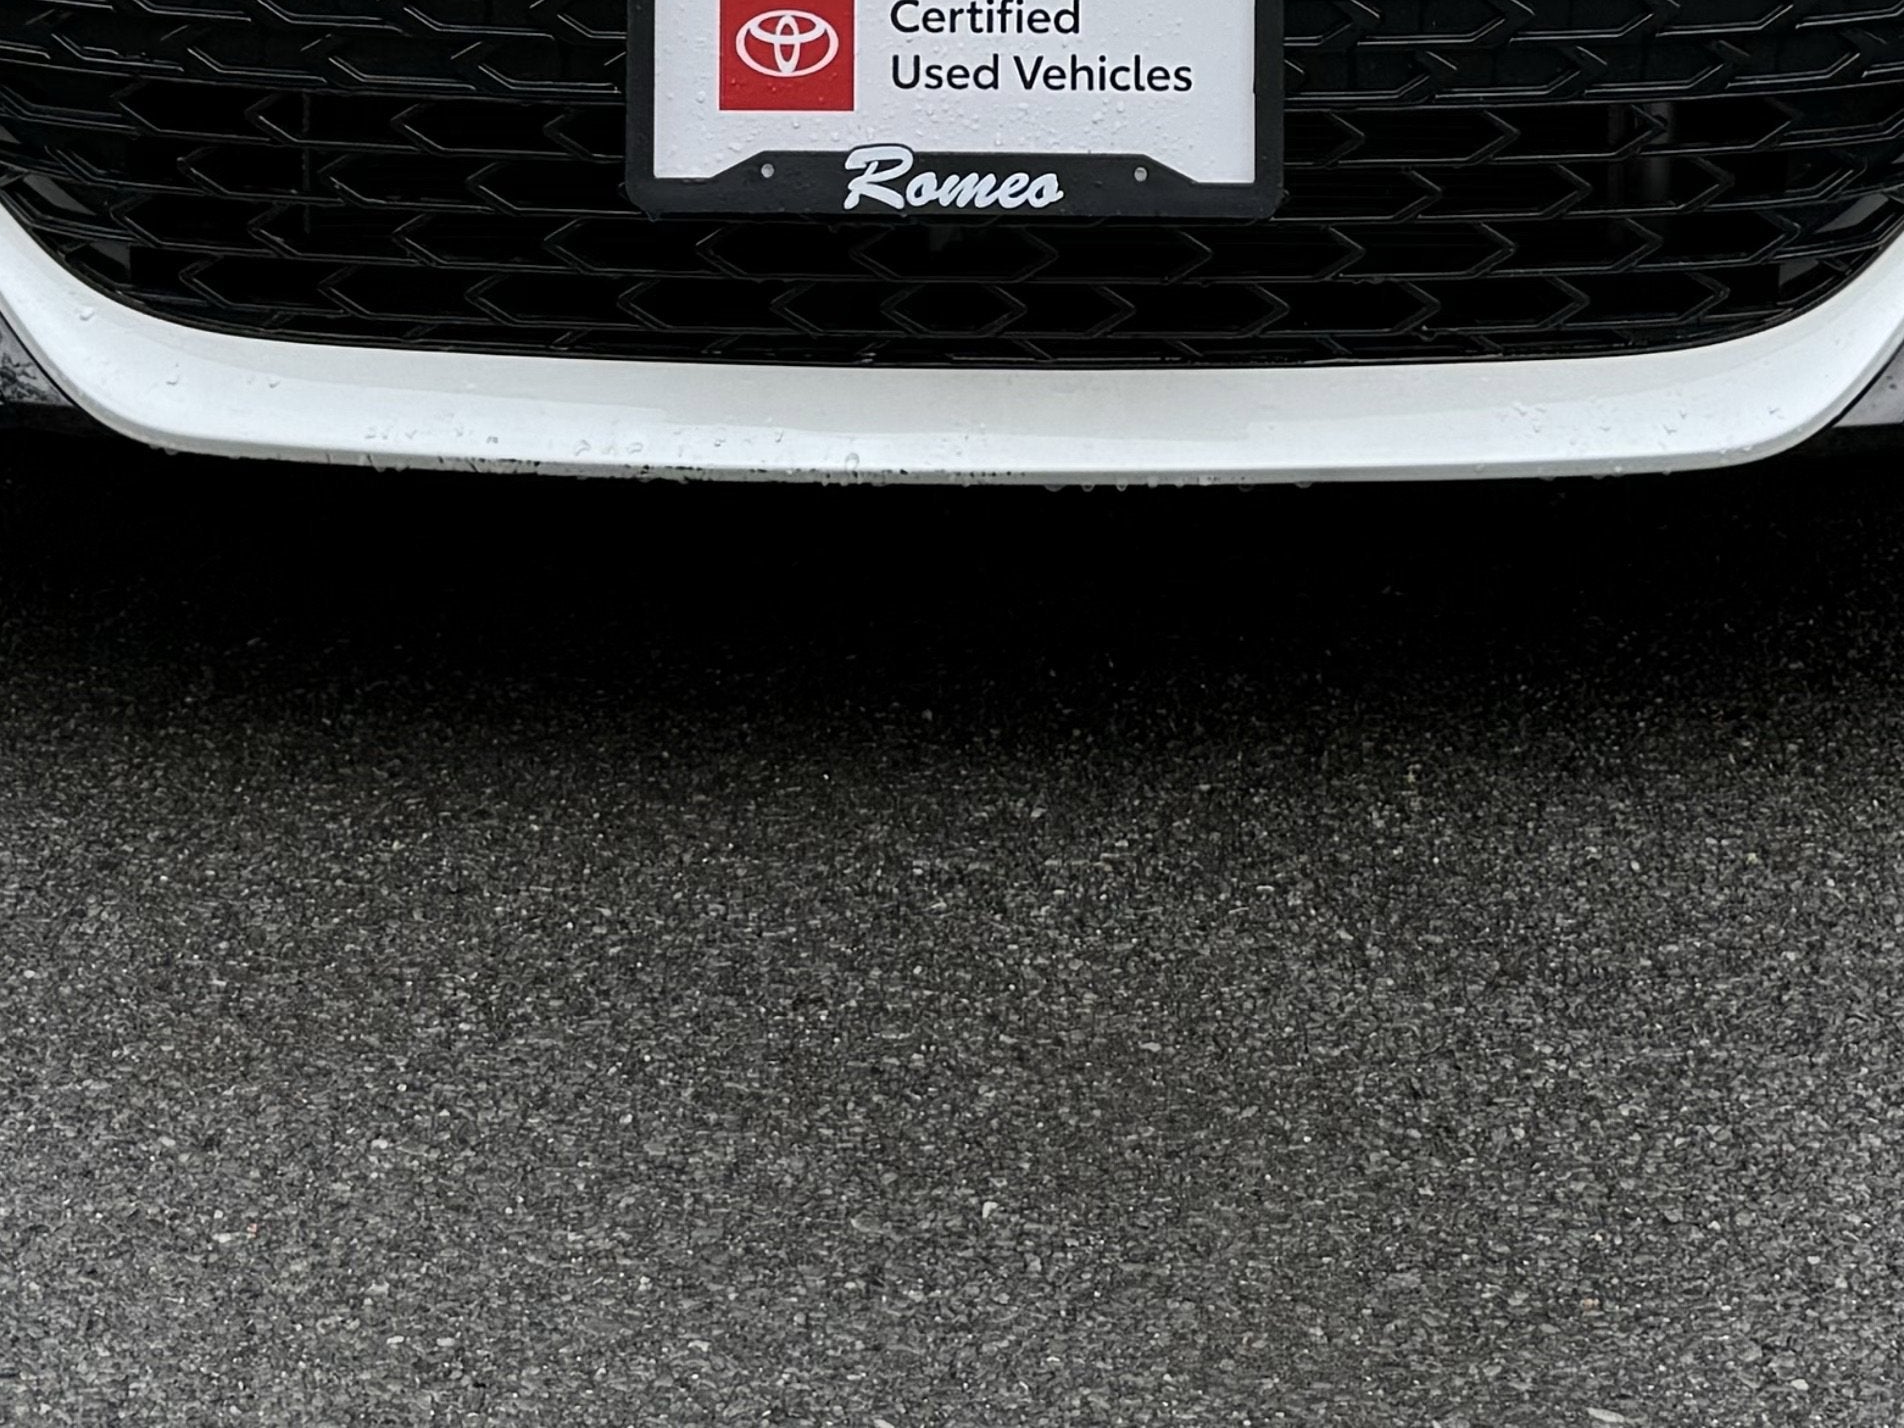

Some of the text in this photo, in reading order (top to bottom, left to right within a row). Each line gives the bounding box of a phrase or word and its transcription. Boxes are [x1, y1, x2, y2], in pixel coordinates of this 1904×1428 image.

[891, 54, 1193, 92] Used Vehicles
[843, 145, 1064, 211] Romeo
